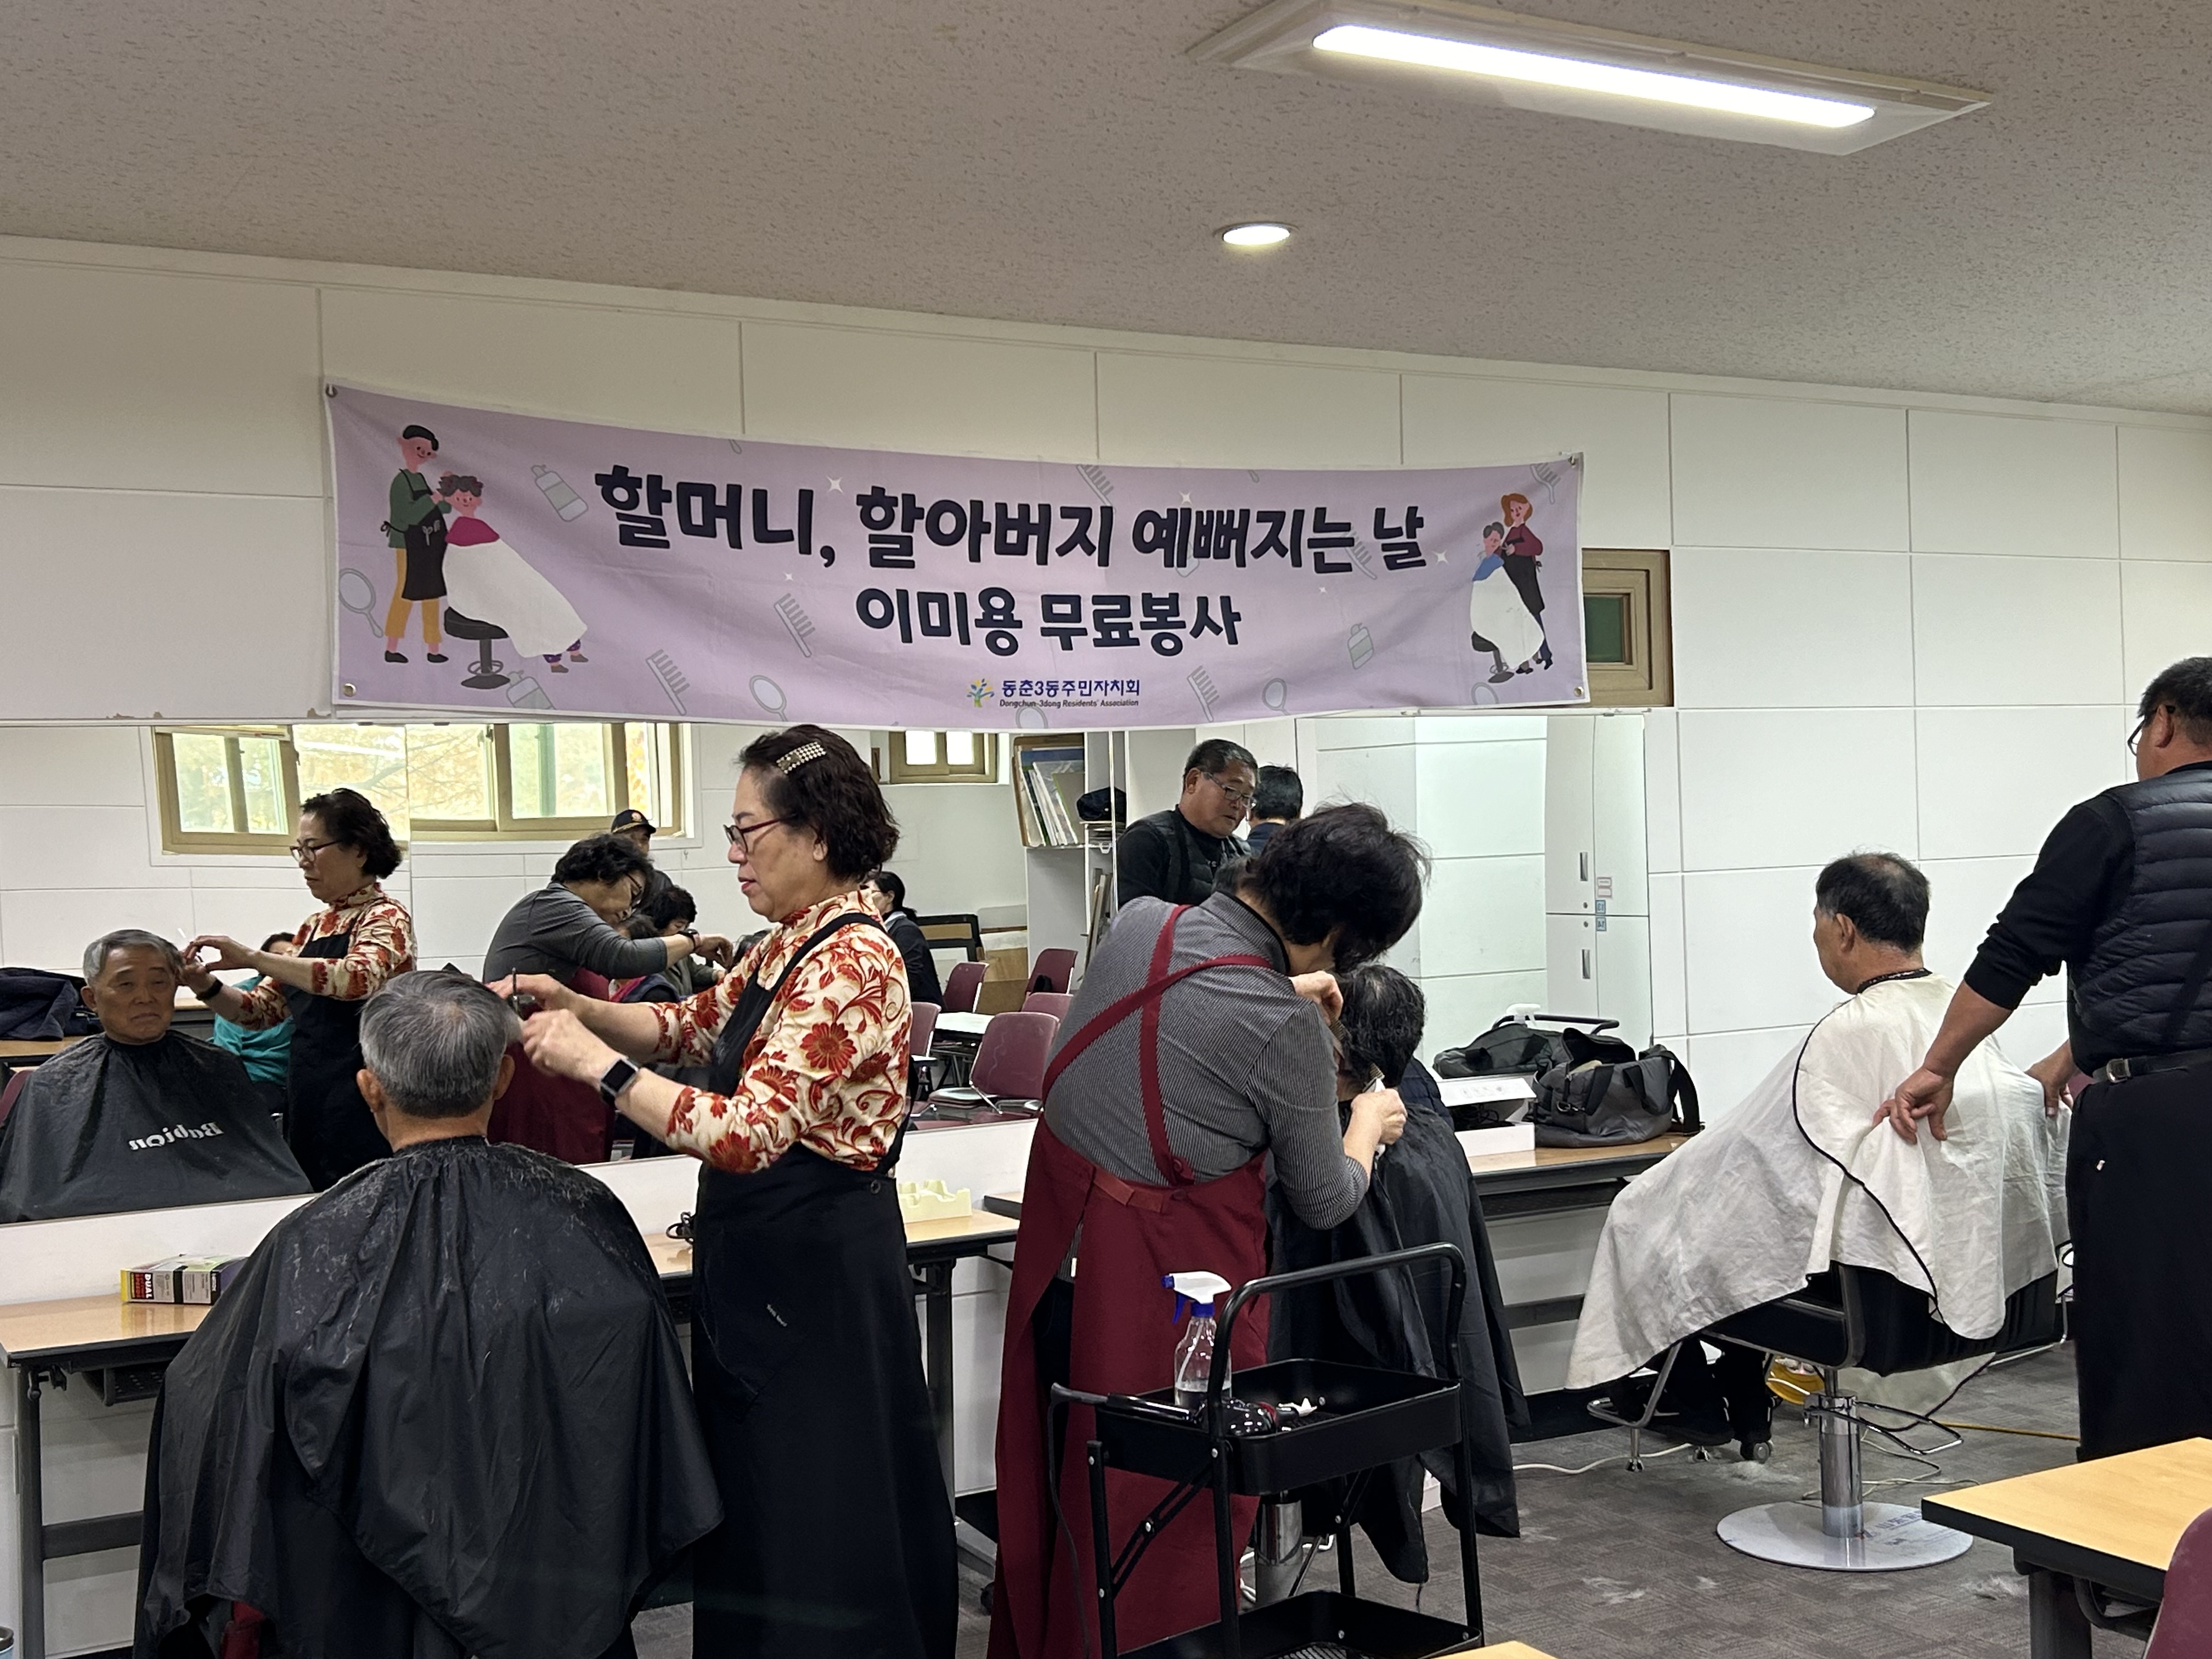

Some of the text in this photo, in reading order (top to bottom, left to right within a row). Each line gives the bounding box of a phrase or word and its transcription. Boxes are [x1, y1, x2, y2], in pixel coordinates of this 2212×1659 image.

[594, 464, 1427, 574] 할머니, 할아버지 예뻐지는 날
[856, 587, 1242, 657] 이미용 무료봉사
[1002, 679, 1139, 697] 동춘3동주민자치회
[1000, 699, 1061, 708] Dongchun-3dong
[1100, 698, 1139, 707] Association
[145, 1273, 153, 1299] DUAL
